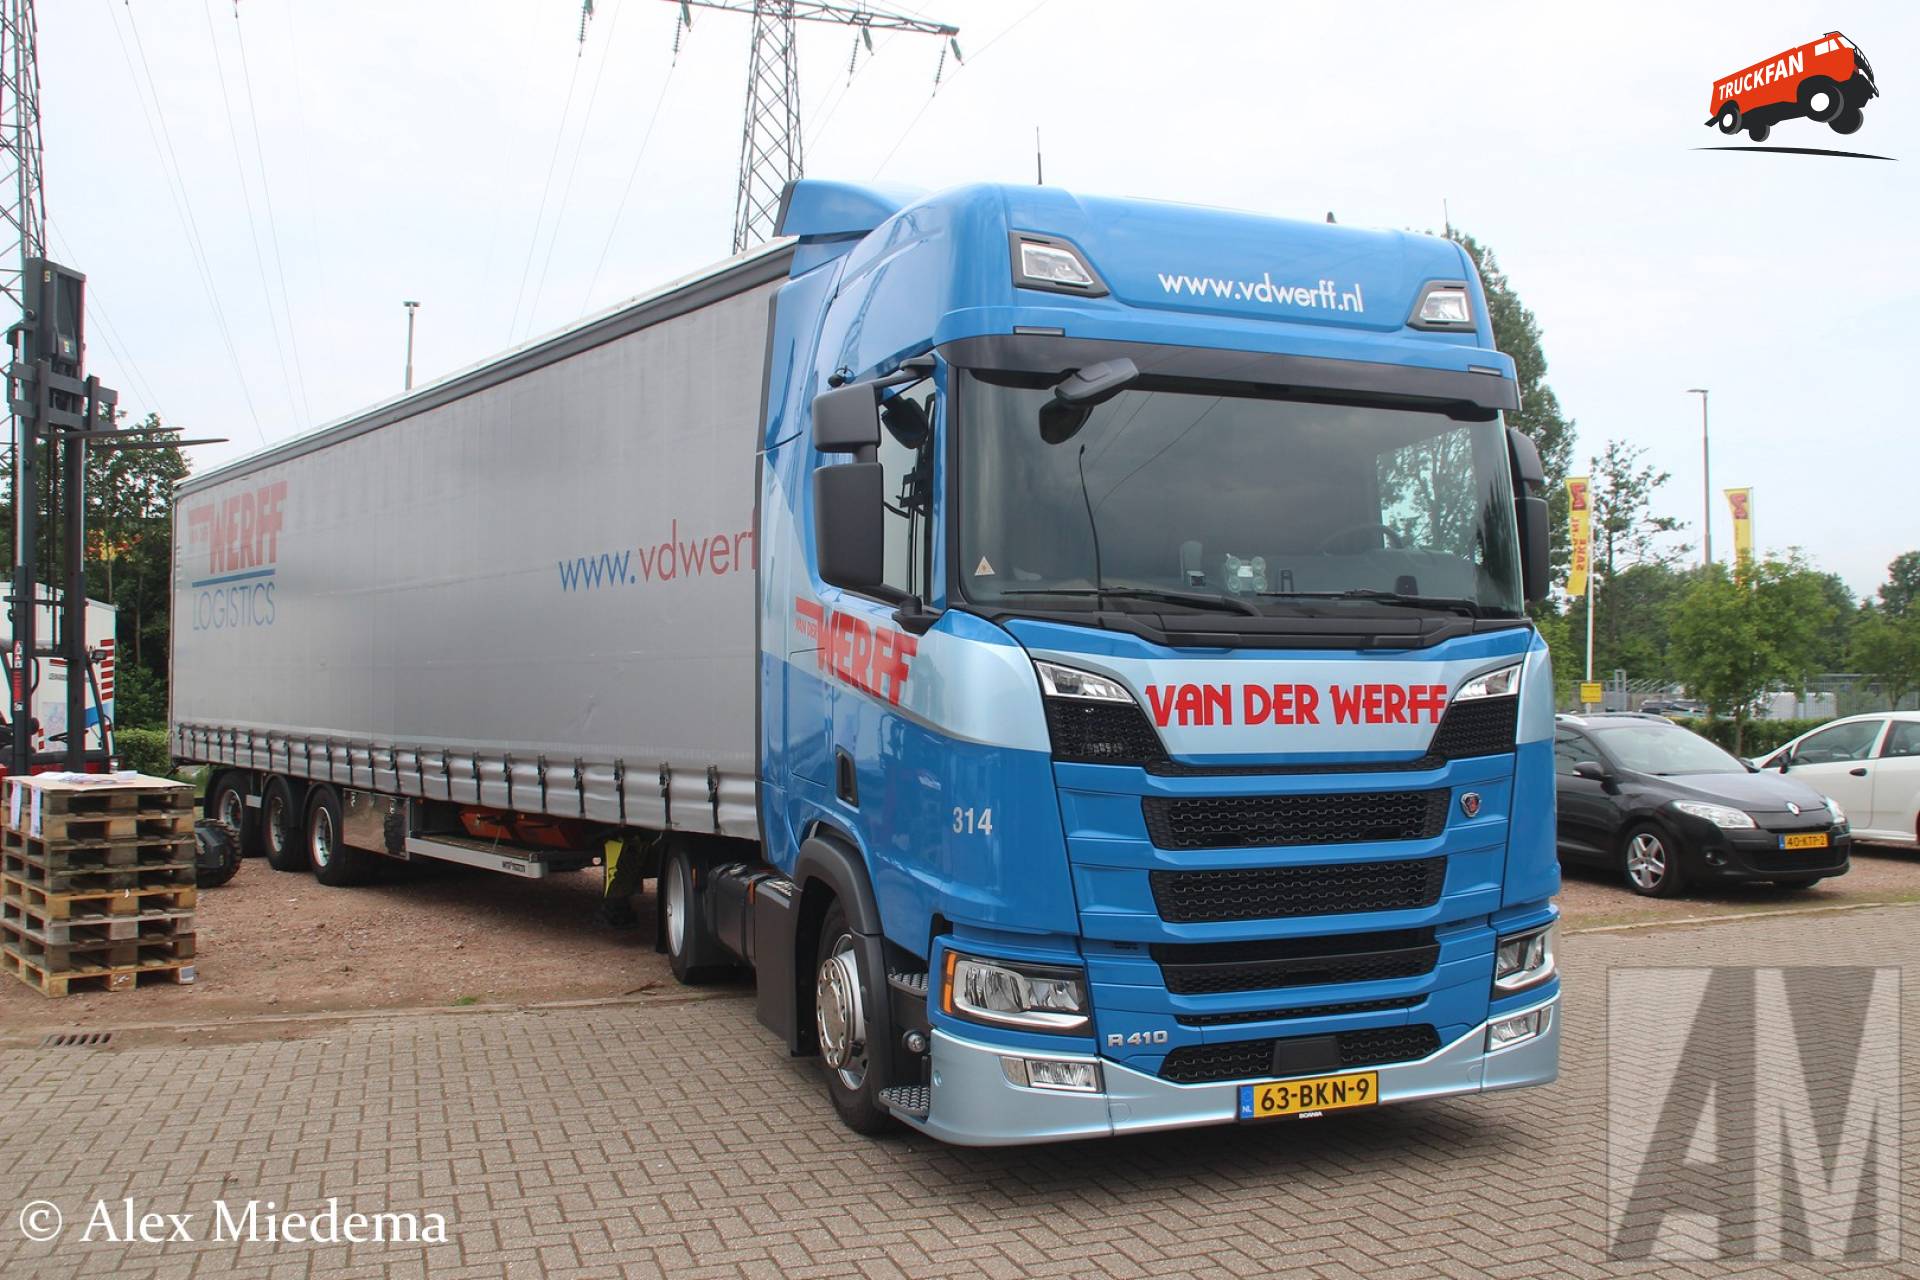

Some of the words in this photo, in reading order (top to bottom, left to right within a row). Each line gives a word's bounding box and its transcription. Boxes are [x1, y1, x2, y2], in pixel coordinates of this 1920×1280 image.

[1157, 272, 1364, 313] www.vdwerff.nl
[188, 480, 288, 575] WERFF
[192, 581, 276, 631] LOGISTICS
[795, 596, 919, 707] WERFF
[1145, 684, 1232, 727] VAN
[1243, 684, 1320, 725] DER
[1329, 684, 1448, 725] WERFF
[953, 806, 993, 835] 314
[1107, 1033, 1124, 1048] R
[1127, 1030, 1168, 1046] 410
[1241, 1105, 1252, 1113] NL
[1261, 1078, 1370, 1111] 63-BKN-9
